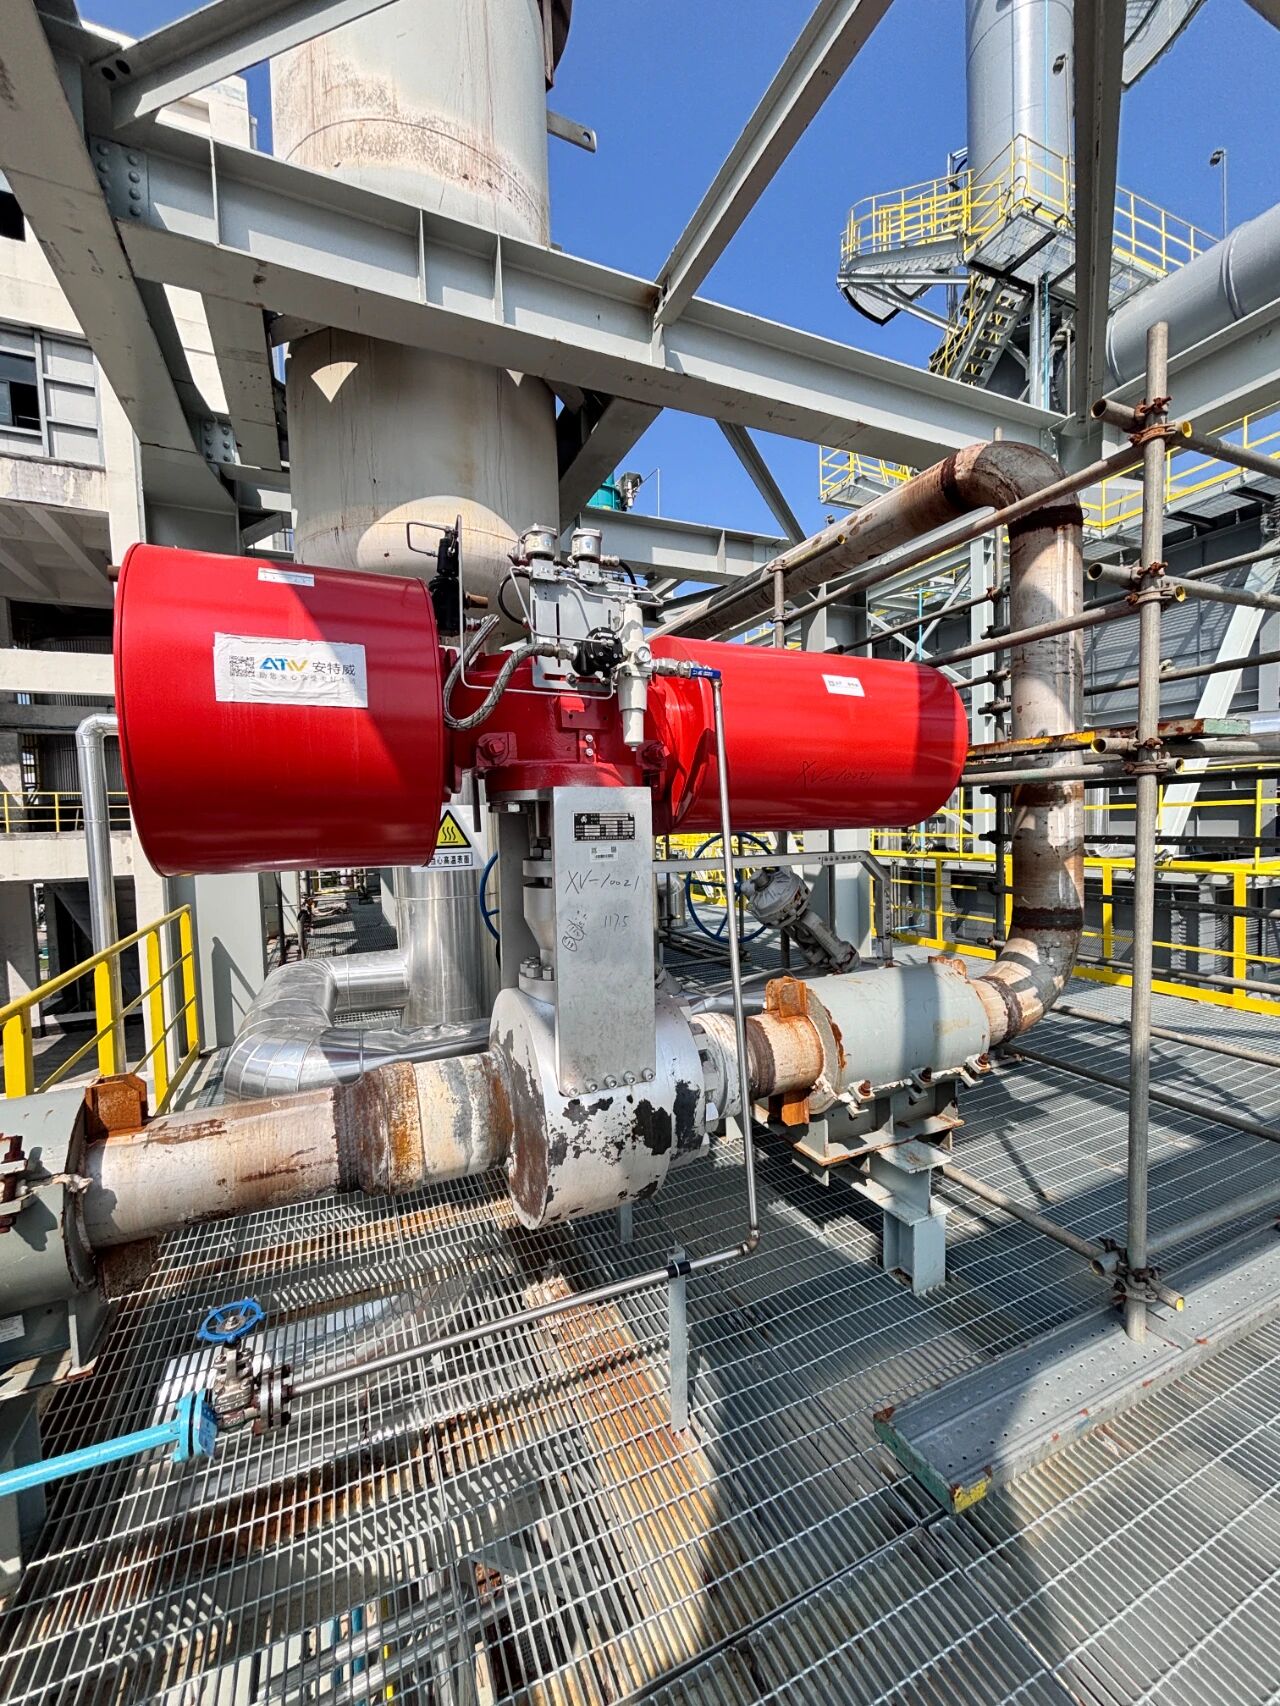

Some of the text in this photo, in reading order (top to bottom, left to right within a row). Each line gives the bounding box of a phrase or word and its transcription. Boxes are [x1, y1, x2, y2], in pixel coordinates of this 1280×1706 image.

[312, 662, 355, 676] 安特威
[565, 869, 640, 894] XV-10021
